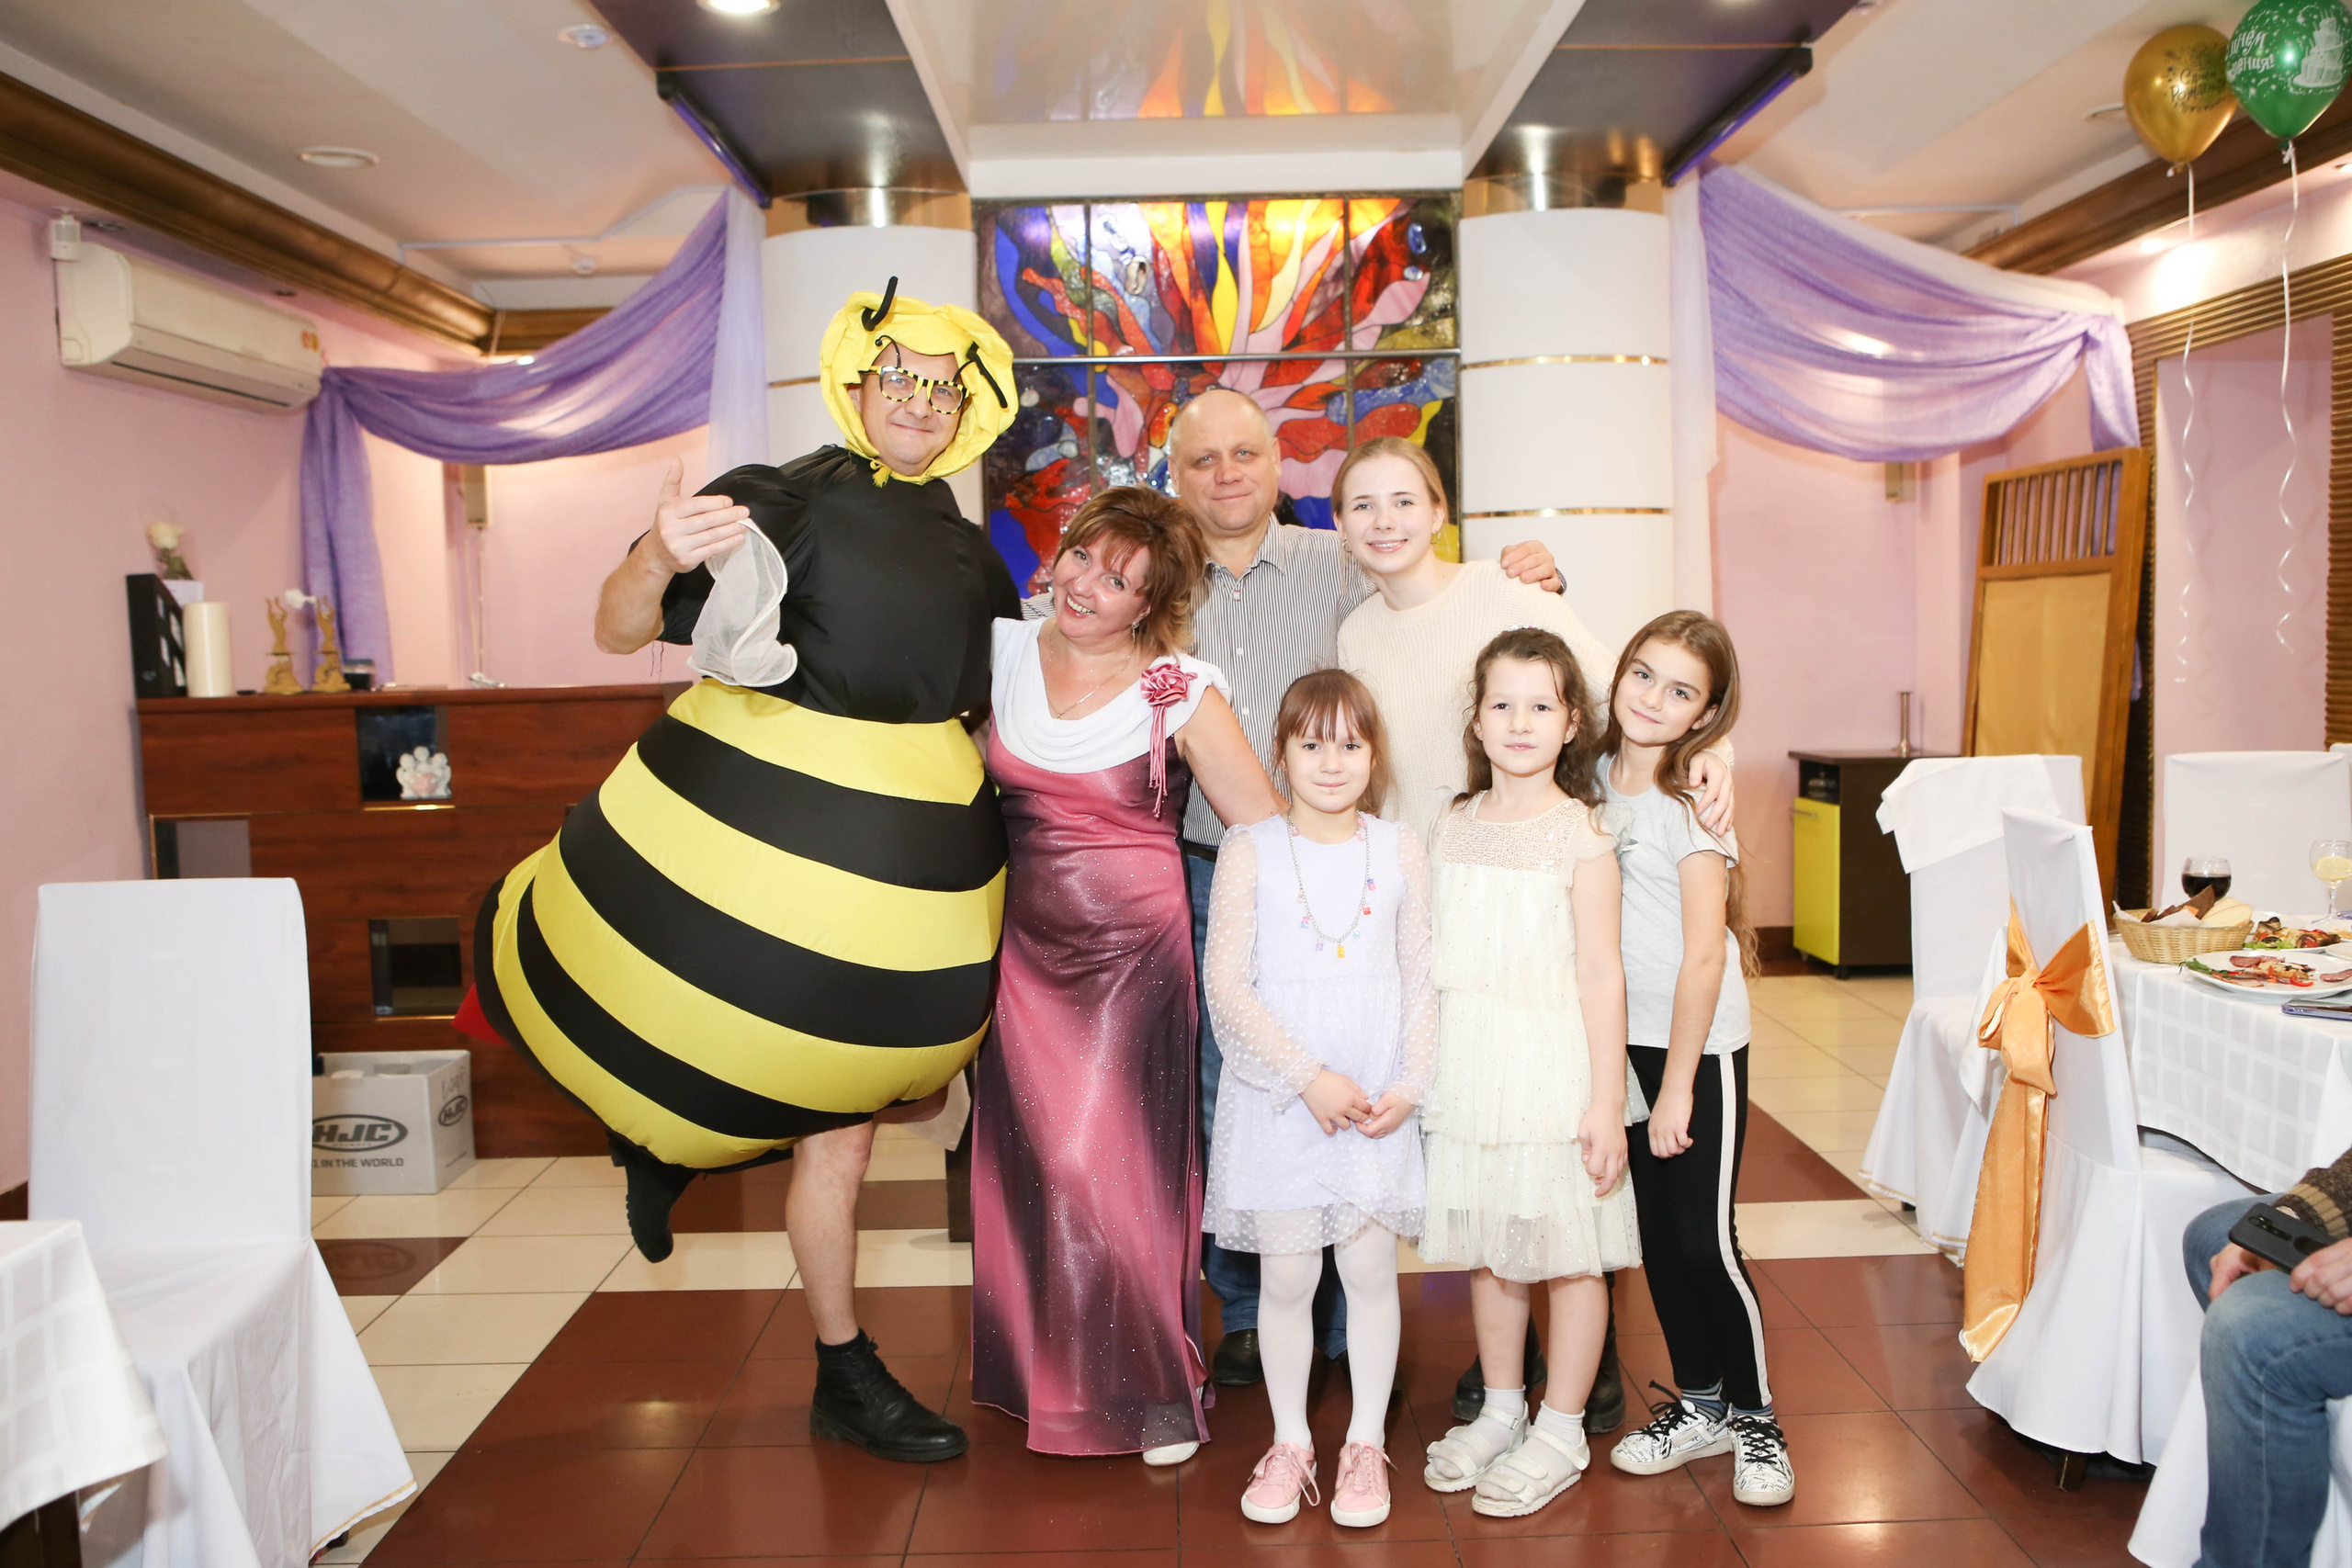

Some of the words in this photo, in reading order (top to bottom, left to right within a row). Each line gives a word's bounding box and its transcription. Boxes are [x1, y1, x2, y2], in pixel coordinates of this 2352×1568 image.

[312, 1123, 392, 1143] HJC
[321, 1158, 334, 1168] IN
[334, 1158, 357, 1168] THE
[359, 1157, 404, 1168] WORLD
